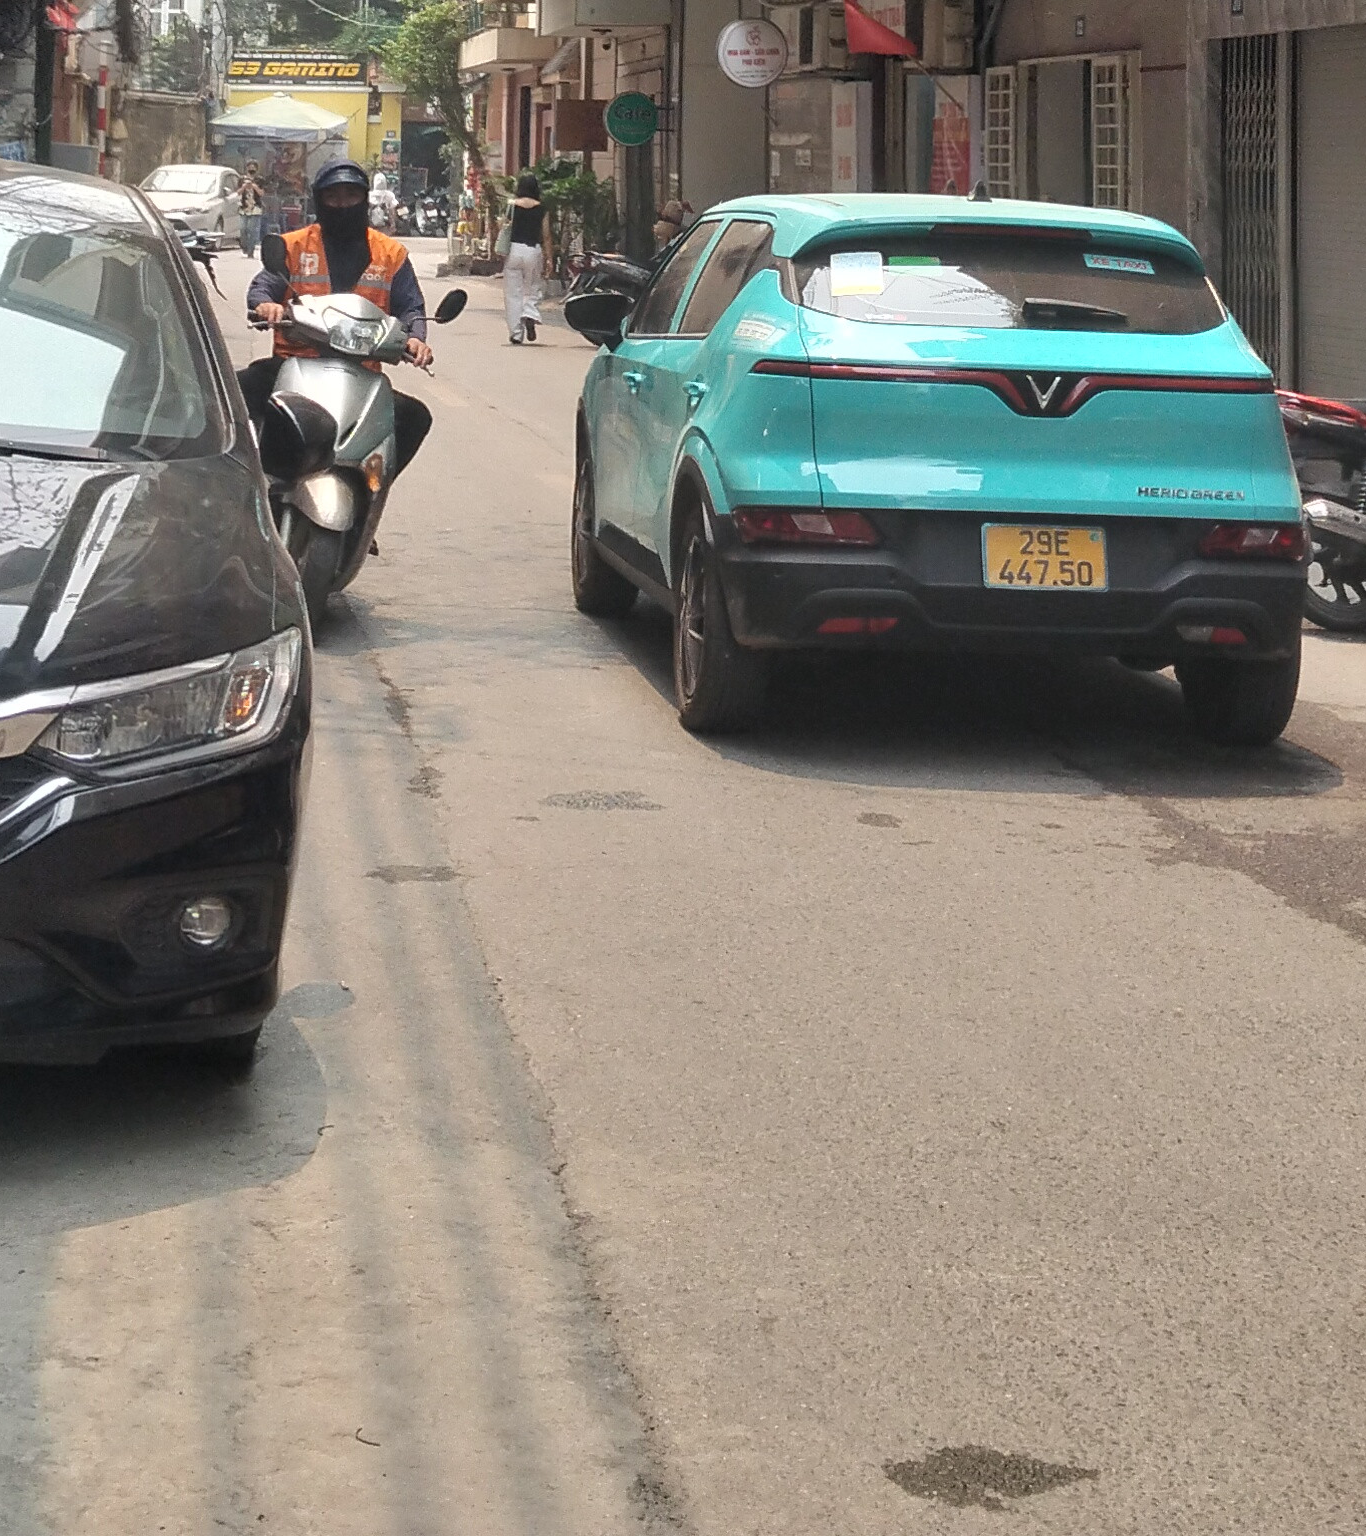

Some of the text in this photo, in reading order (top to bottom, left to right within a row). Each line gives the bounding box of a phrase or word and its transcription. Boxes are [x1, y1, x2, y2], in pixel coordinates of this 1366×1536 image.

[263, 62, 361, 78] GAMING
[1019, 530, 1069, 556] 29E
[999, 559, 1093, 586] 447.50
